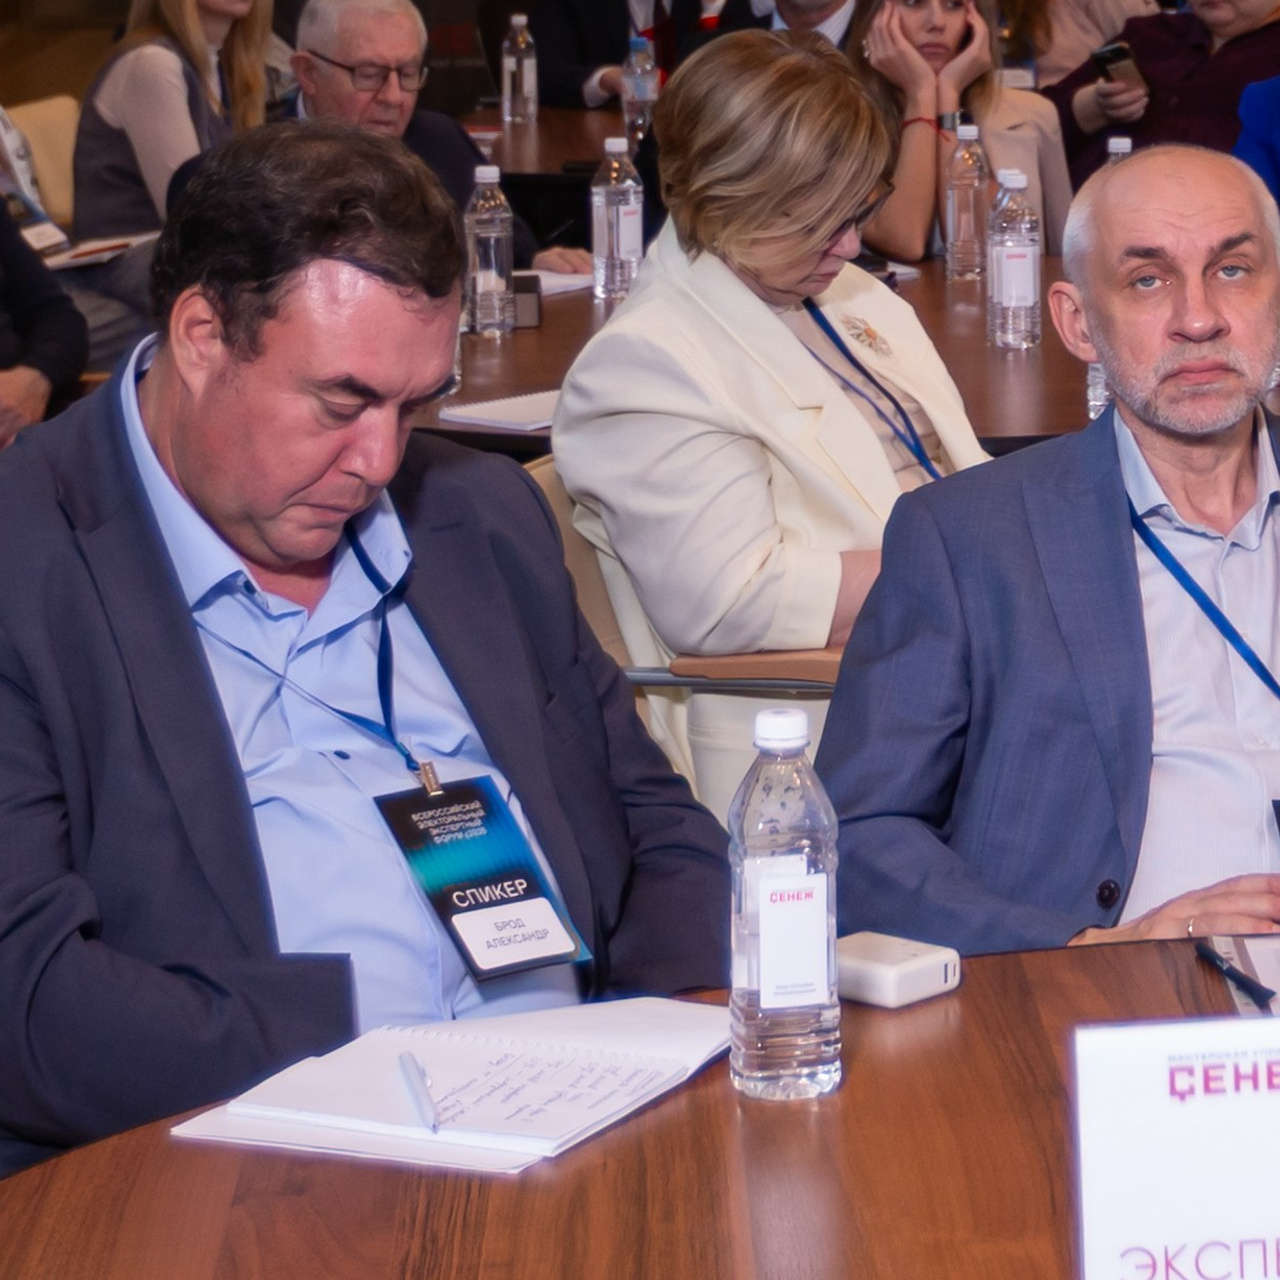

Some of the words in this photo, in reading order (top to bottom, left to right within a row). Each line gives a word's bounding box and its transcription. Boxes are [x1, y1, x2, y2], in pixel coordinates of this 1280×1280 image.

[452, 878, 528, 908] СПИКЕР
[770, 890, 814, 904] СЕНЕЖ
[494, 918, 526, 932] БРОД
[486, 928, 549, 950] АЛЕКСАНДР
